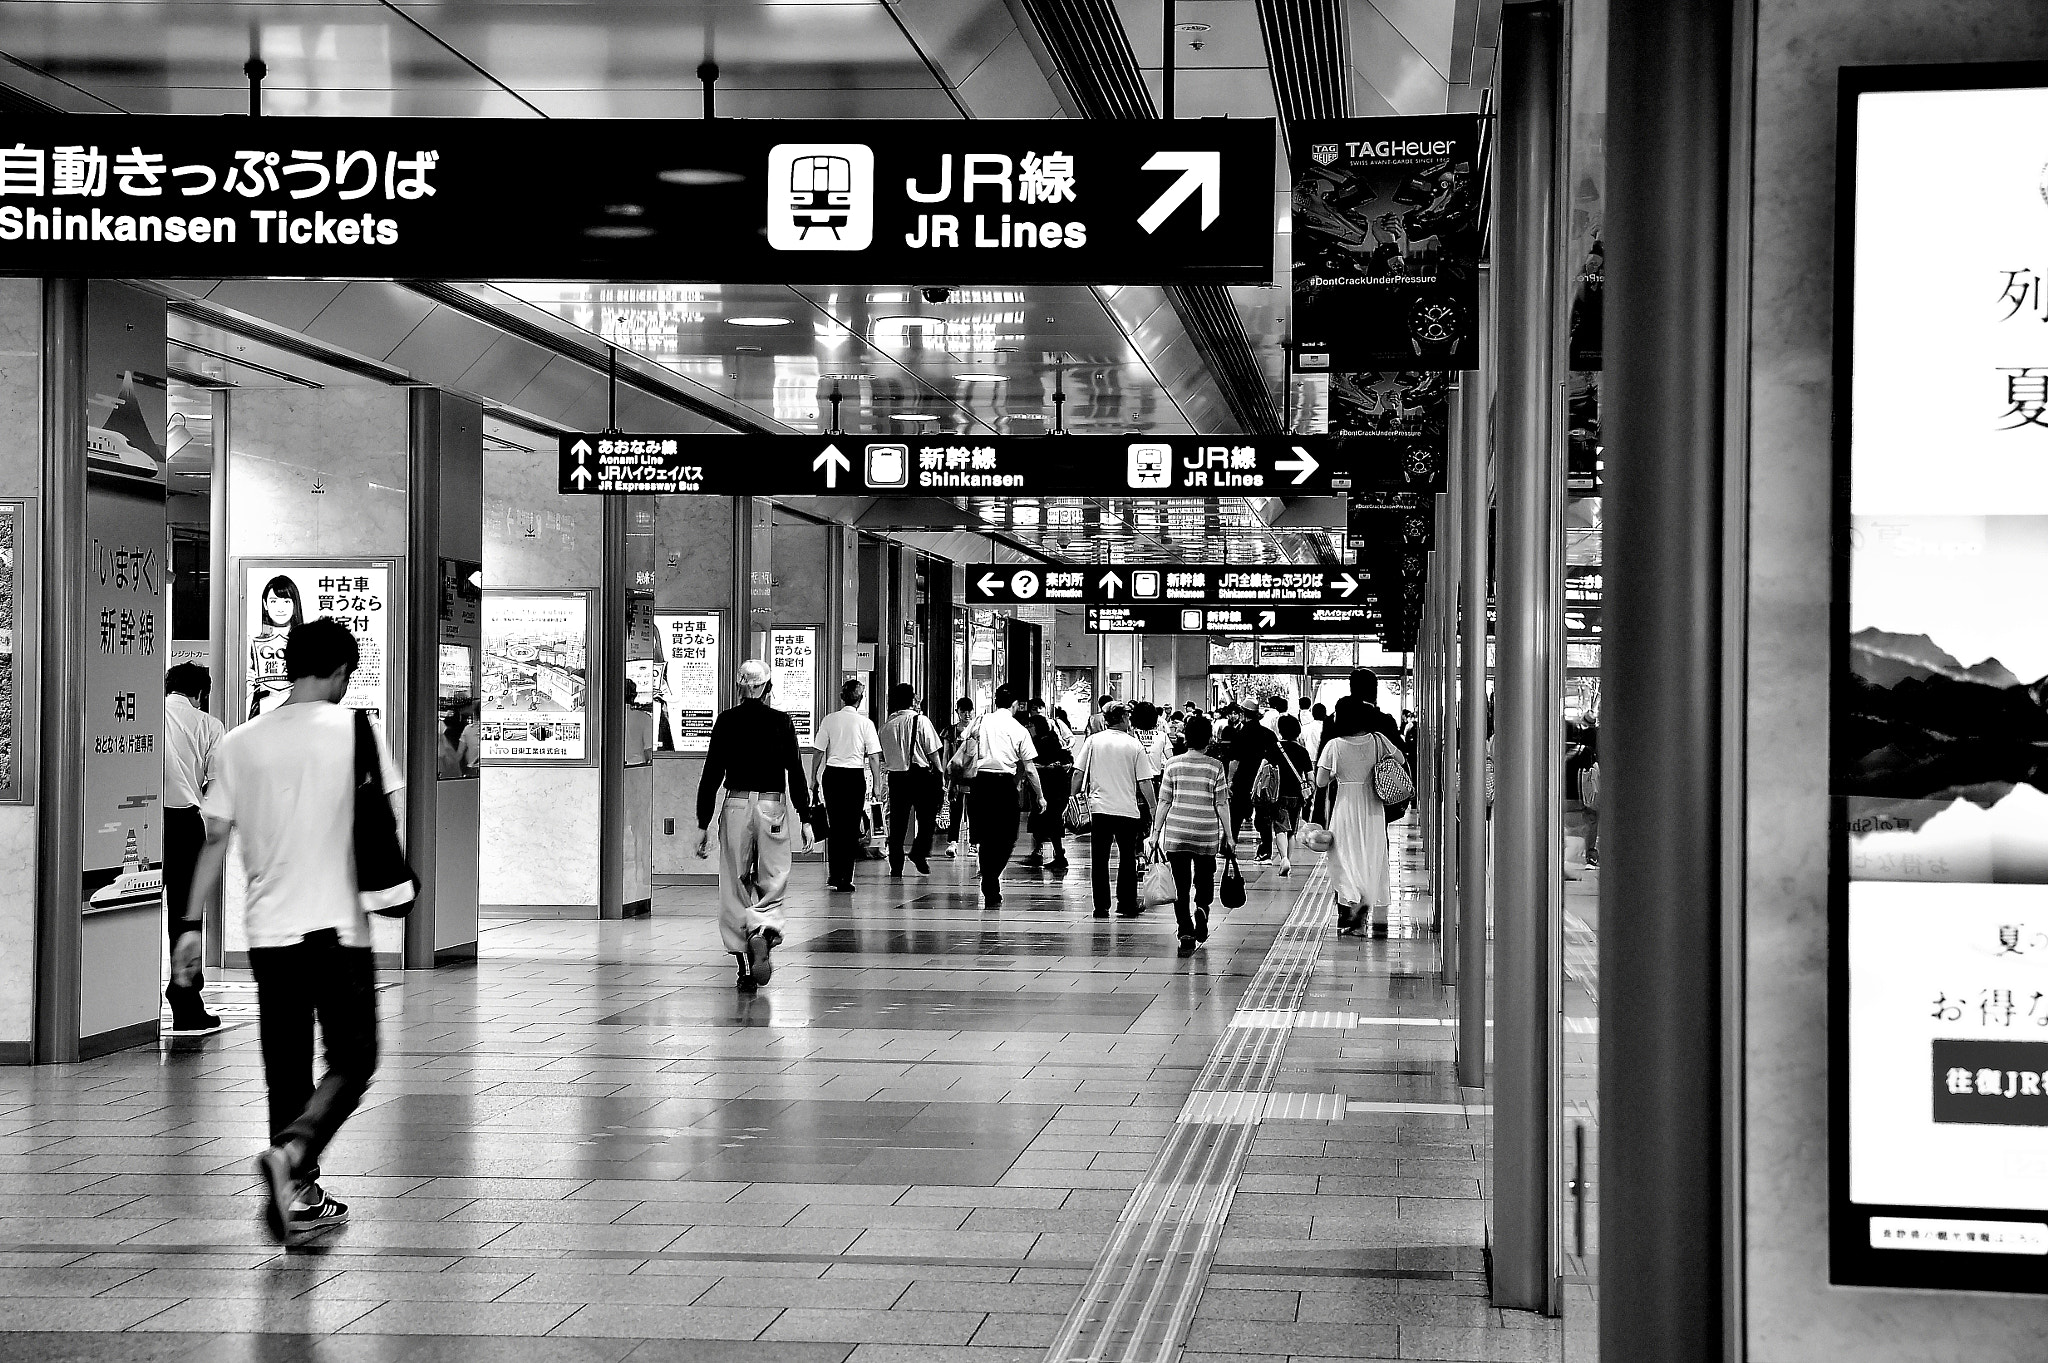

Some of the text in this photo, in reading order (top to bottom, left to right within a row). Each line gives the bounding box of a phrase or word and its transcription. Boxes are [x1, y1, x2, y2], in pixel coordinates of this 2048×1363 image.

[1350, 159, 1368, 167] SWISS
[0, 143, 439, 200] 自動きっぷうりば
[906, 151, 1076, 204] JR線
[0, 206, 398, 244] Shinkansen Tickets
[906, 215, 1086, 248] JR Lines
[1310, 276, 1437, 286] #DontCrackUnderPressure
[1996, 367, 2048, 431] 夏
[599, 440, 677, 457] あおなみ線
[599, 455, 663, 464] Aonami Line
[920, 446, 996, 470] 新幹線
[1184, 446, 1256, 469] JR線
[598, 466, 703, 480] JRハイウェイバス
[920, 471, 1023, 486] Shinkansen
[1184, 472, 1263, 486] JR Lines
[598, 481, 699, 492] JR Expressway Bus
[92, 539, 159, 595] 「いますぐ」
[319, 576, 369, 592] 中古車
[1046, 572, 1084, 587] 案内所
[1167, 573, 1205, 587] 新幹線
[319, 595, 381, 611] 買うなら
[100, 607, 155, 656] 新幹線
[673, 621, 707, 632] 中古車
[672, 634, 714, 644] 買うなら
[775, 635, 804, 644] 中古車
[672, 647, 706, 658] 鑑定付
[775, 646, 811, 655] 買うなら
[775, 658, 803, 667] 鑑定付
[114, 690, 136, 723] 本日
